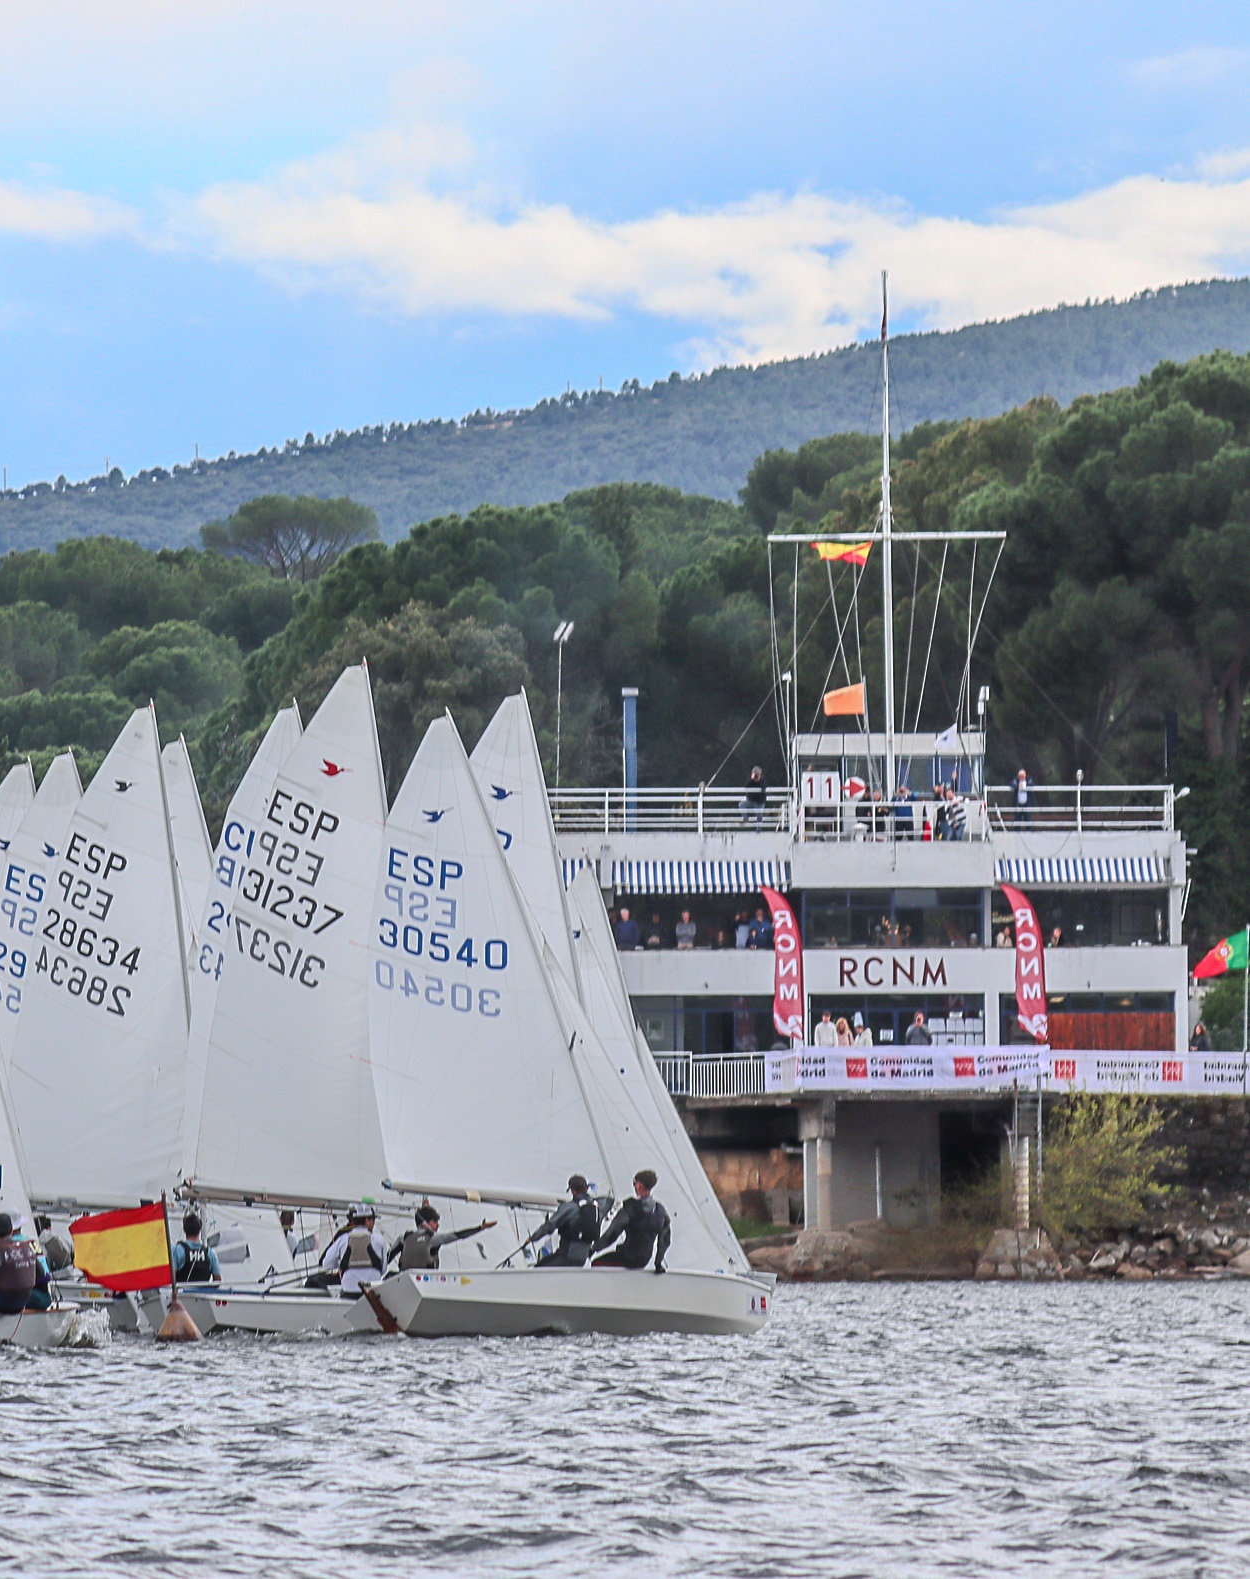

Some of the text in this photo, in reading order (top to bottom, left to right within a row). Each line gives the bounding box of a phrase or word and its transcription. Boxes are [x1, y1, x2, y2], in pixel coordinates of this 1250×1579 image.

[807, 776, 833, 799] 11
[266, 788, 340, 841] ESP
[65, 831, 128, 881] ESP
[388, 846, 463, 890] ESP
[4, 864, 47, 903] ES
[241, 868, 344, 935] 31237
[42, 908, 141, 976] 28634
[378, 917, 508, 971] 30540
[799, 1069, 826, 1078] drid
[870, 1057, 933, 1066] Comunidad
[871, 1068, 934, 1078] de Madrid
